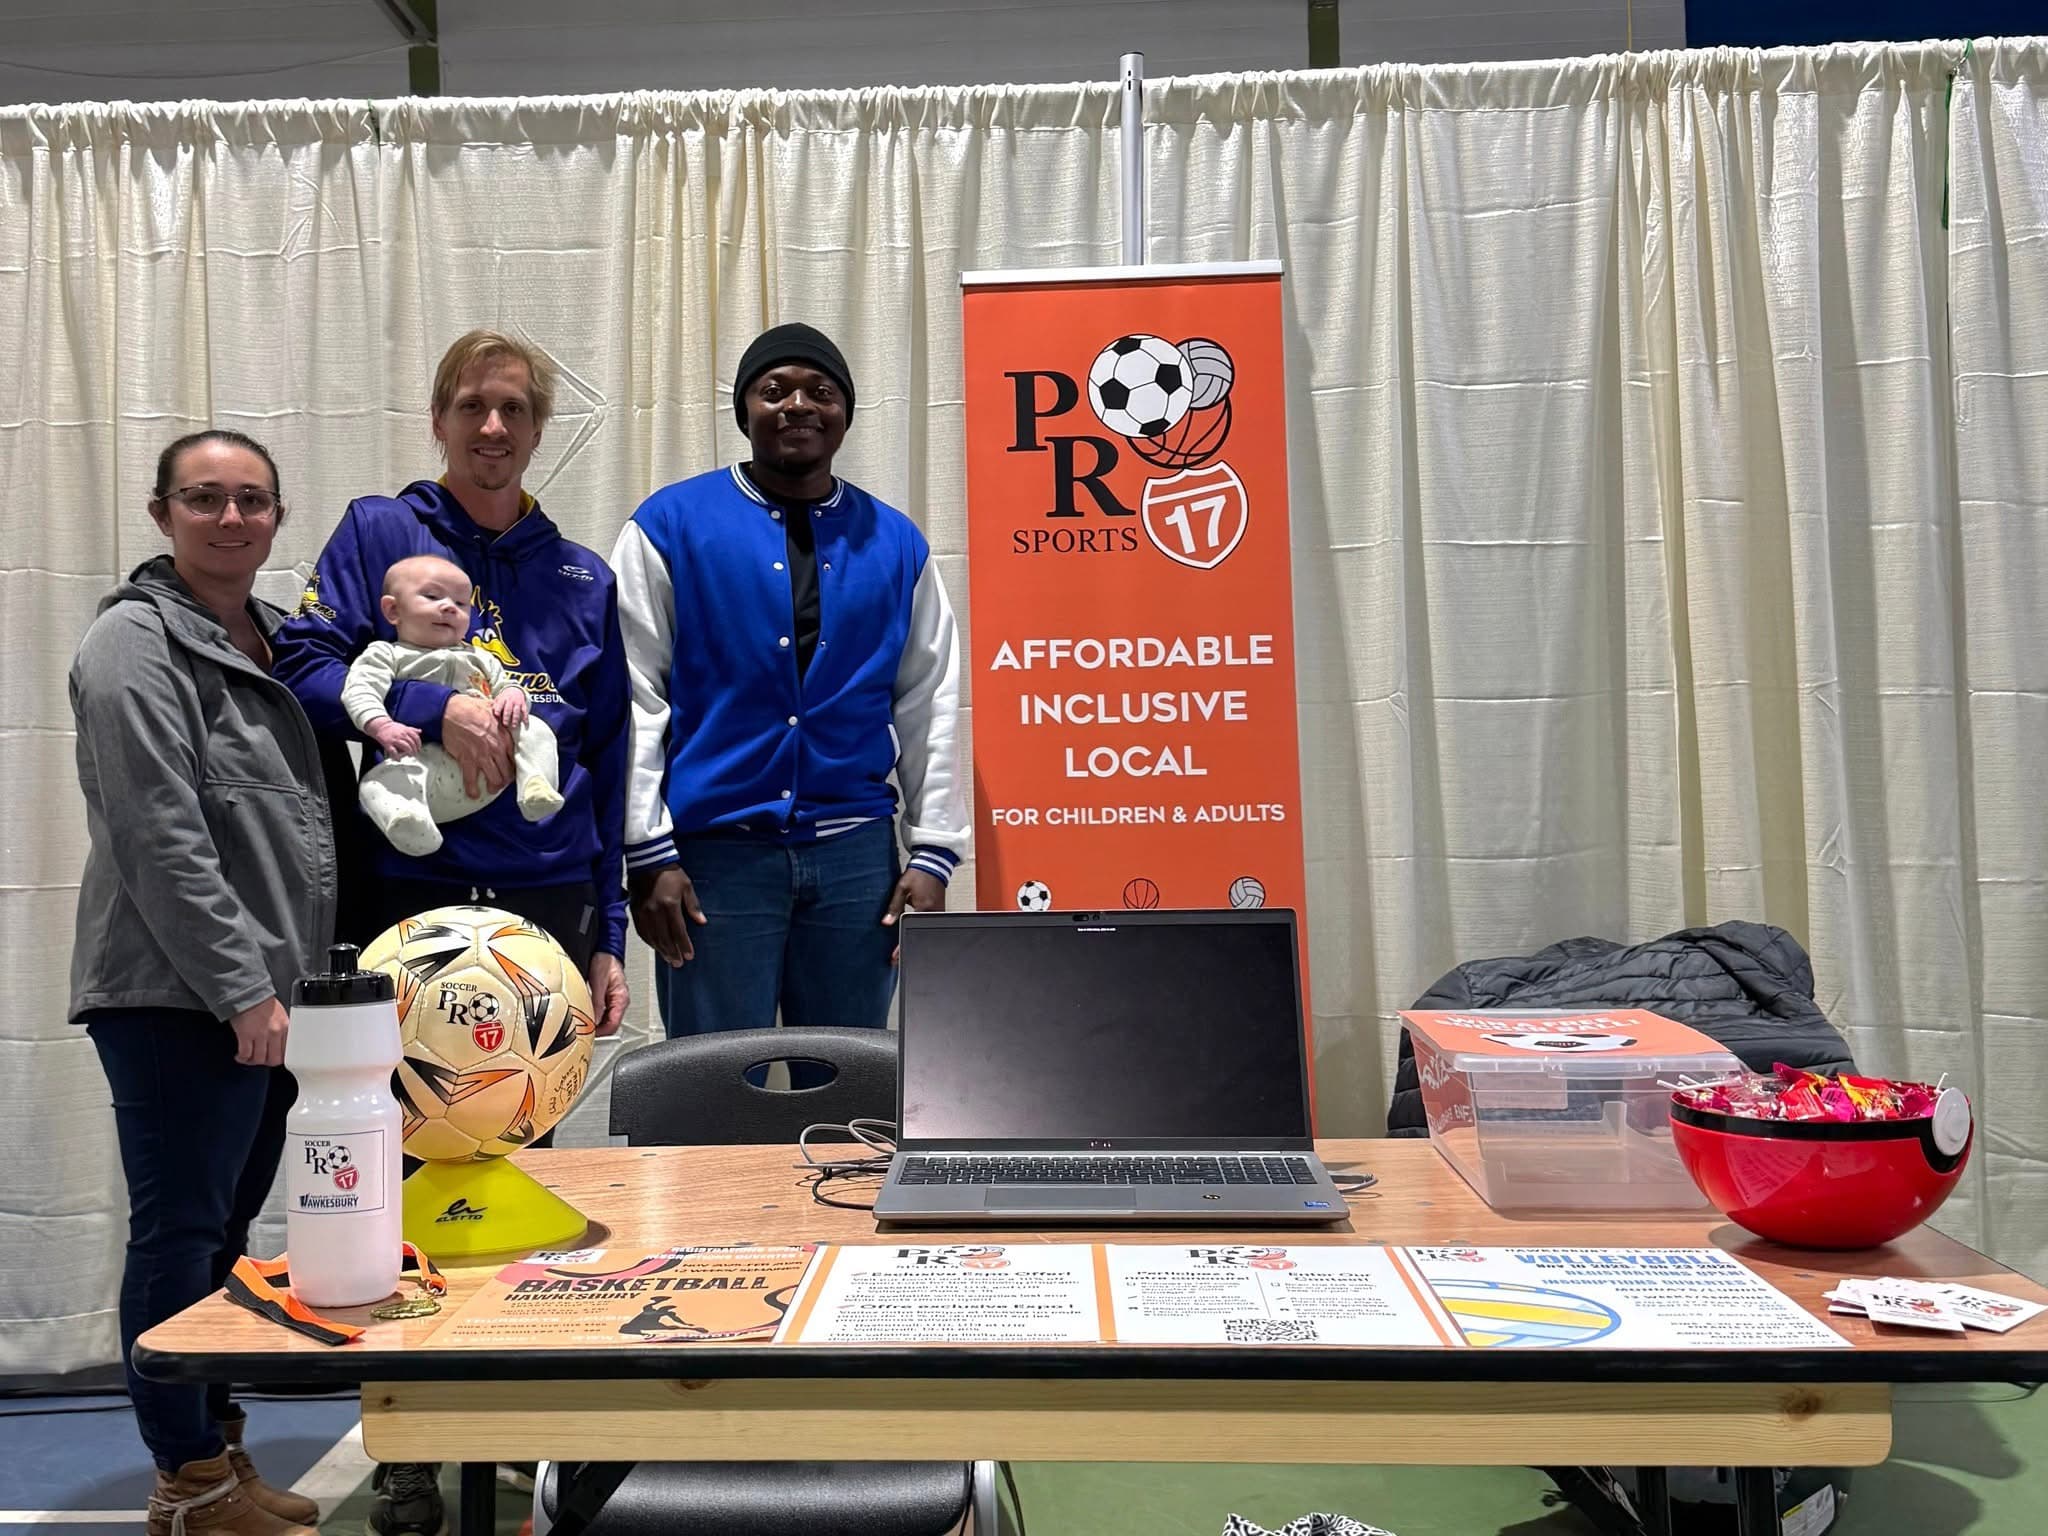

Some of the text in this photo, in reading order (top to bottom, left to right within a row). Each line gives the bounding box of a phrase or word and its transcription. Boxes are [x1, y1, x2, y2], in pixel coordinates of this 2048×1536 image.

[1164, 494, 1228, 555] 17
[1012, 526, 1138, 554] SPORTS
[990, 633, 1274, 671] AFFORDABLE
[1019, 690, 1249, 725] INCLUSIVE
[1064, 744, 1208, 778] LOCAL
[991, 803, 1286, 826] FOR CHILDREN & ADULTS
[440, 981, 478, 992] SOCCER
[479, 1029, 500, 1048] 17
[338, 1173, 355, 1189] 17
[1513, 1254, 1730, 1265] VOLLEYBALL
[513, 1276, 771, 1294] BASKETBALL
[503, 1292, 642, 1302] HAWKESBURY
